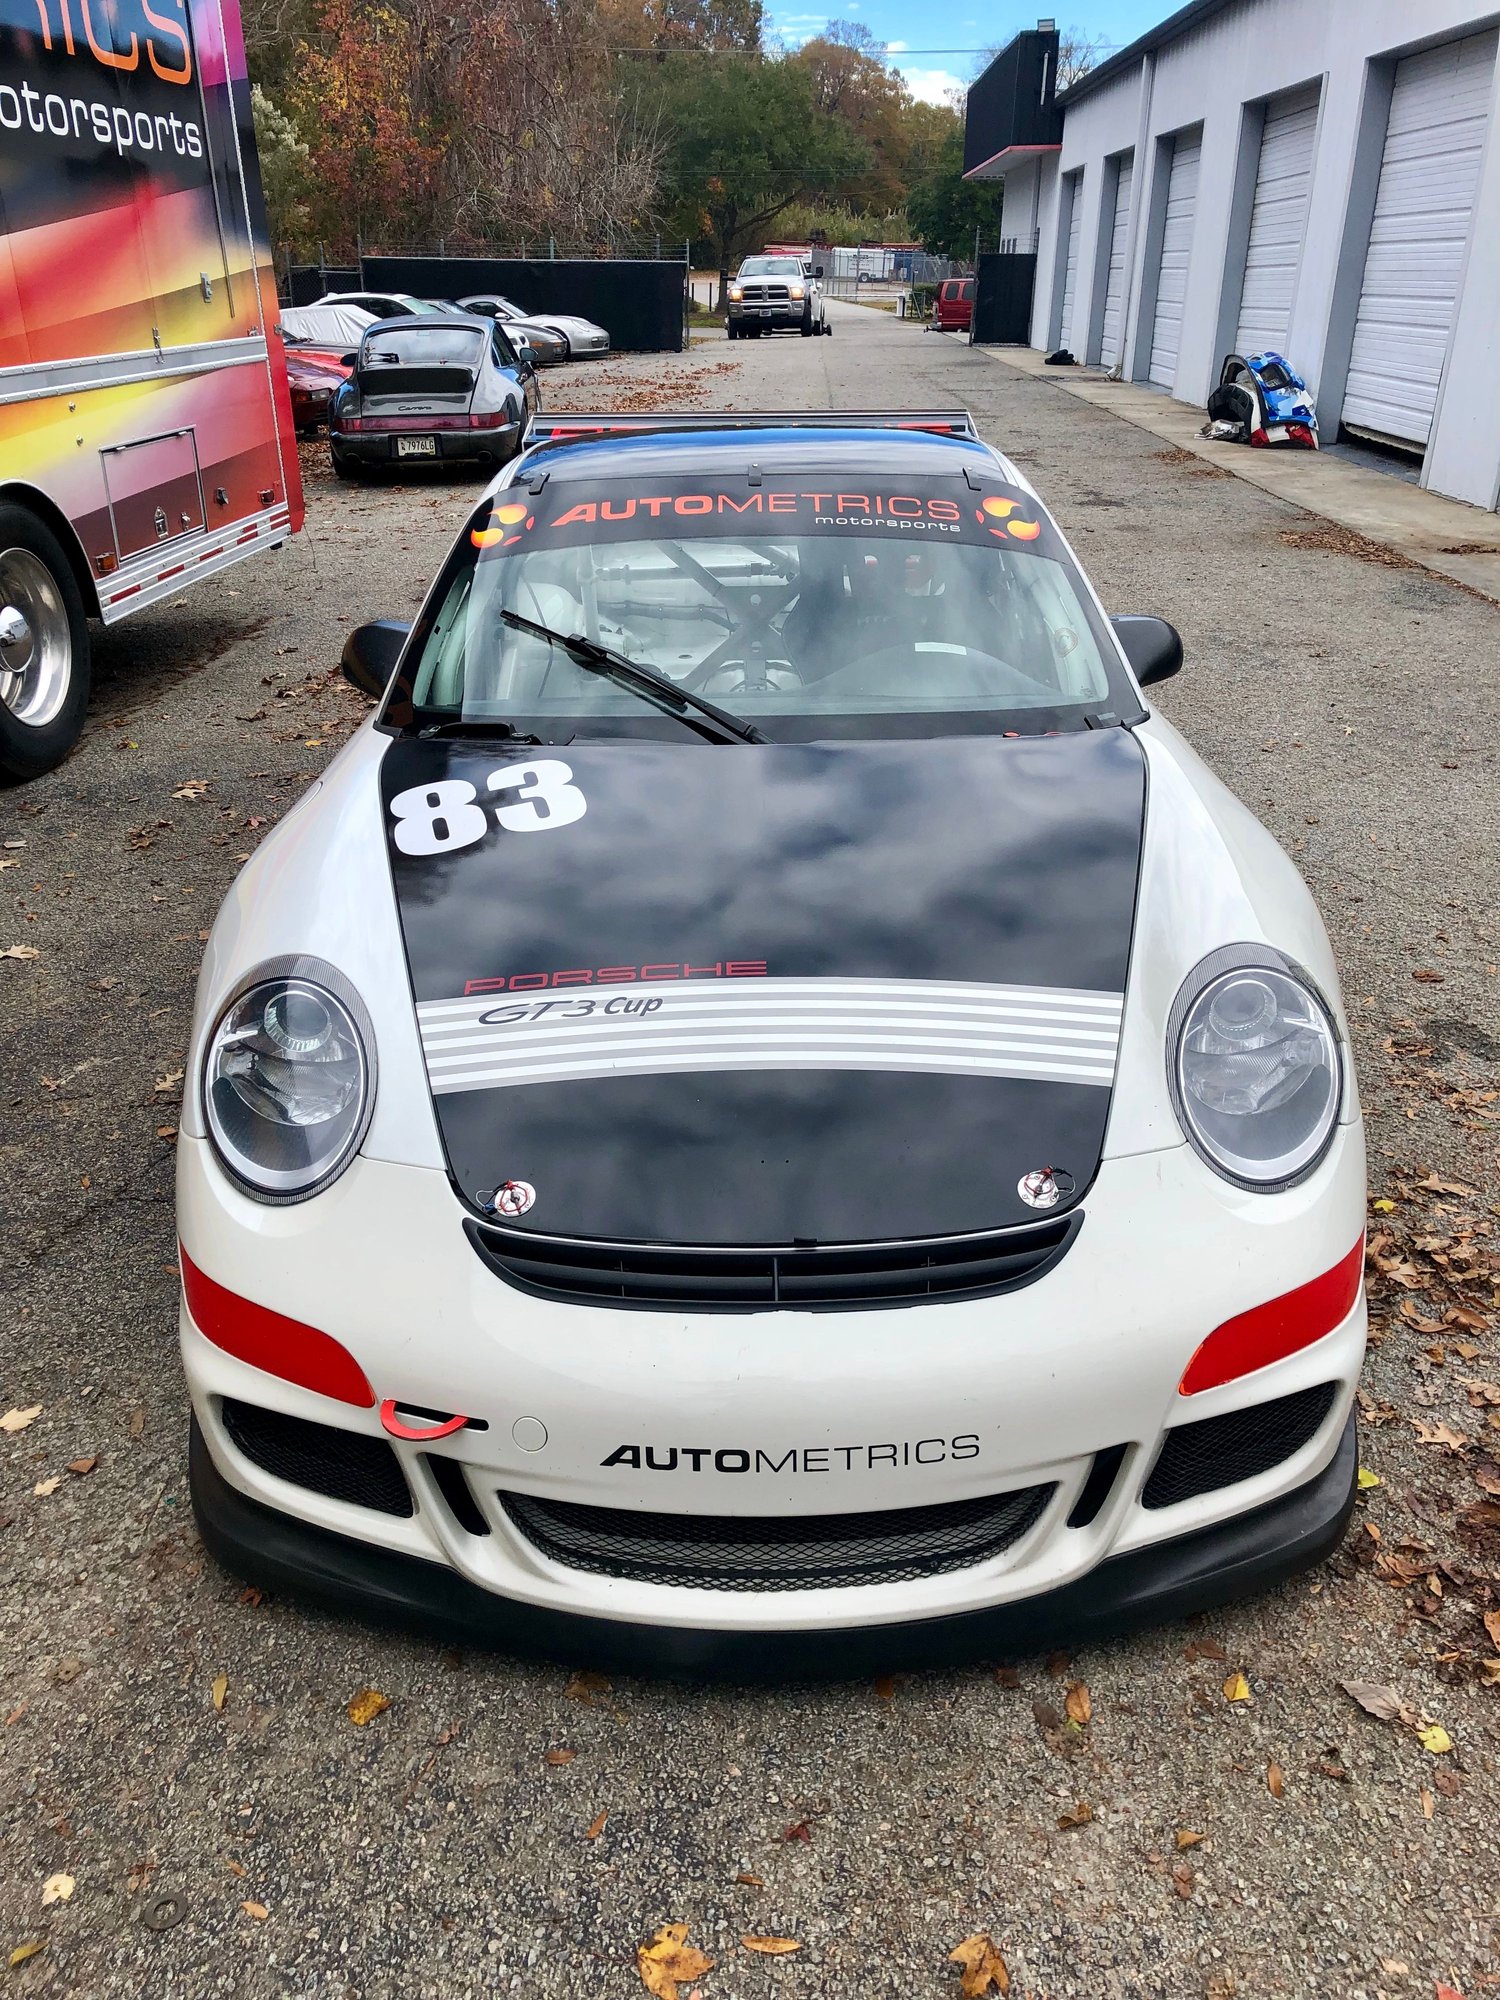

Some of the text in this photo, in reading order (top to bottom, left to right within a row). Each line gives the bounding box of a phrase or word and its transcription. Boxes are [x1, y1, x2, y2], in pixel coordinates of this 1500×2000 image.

[407, 440, 434, 451] 7976LG
[550, 493, 961, 527] AUTOMETRICS
[815, 515, 961, 533] motorsports
[390, 759, 587, 856] 83
[464, 960, 767, 996] PORSCHE
[604, 996, 663, 1017] Cup
[600, 1434, 980, 1473] AUTOMETRICS
